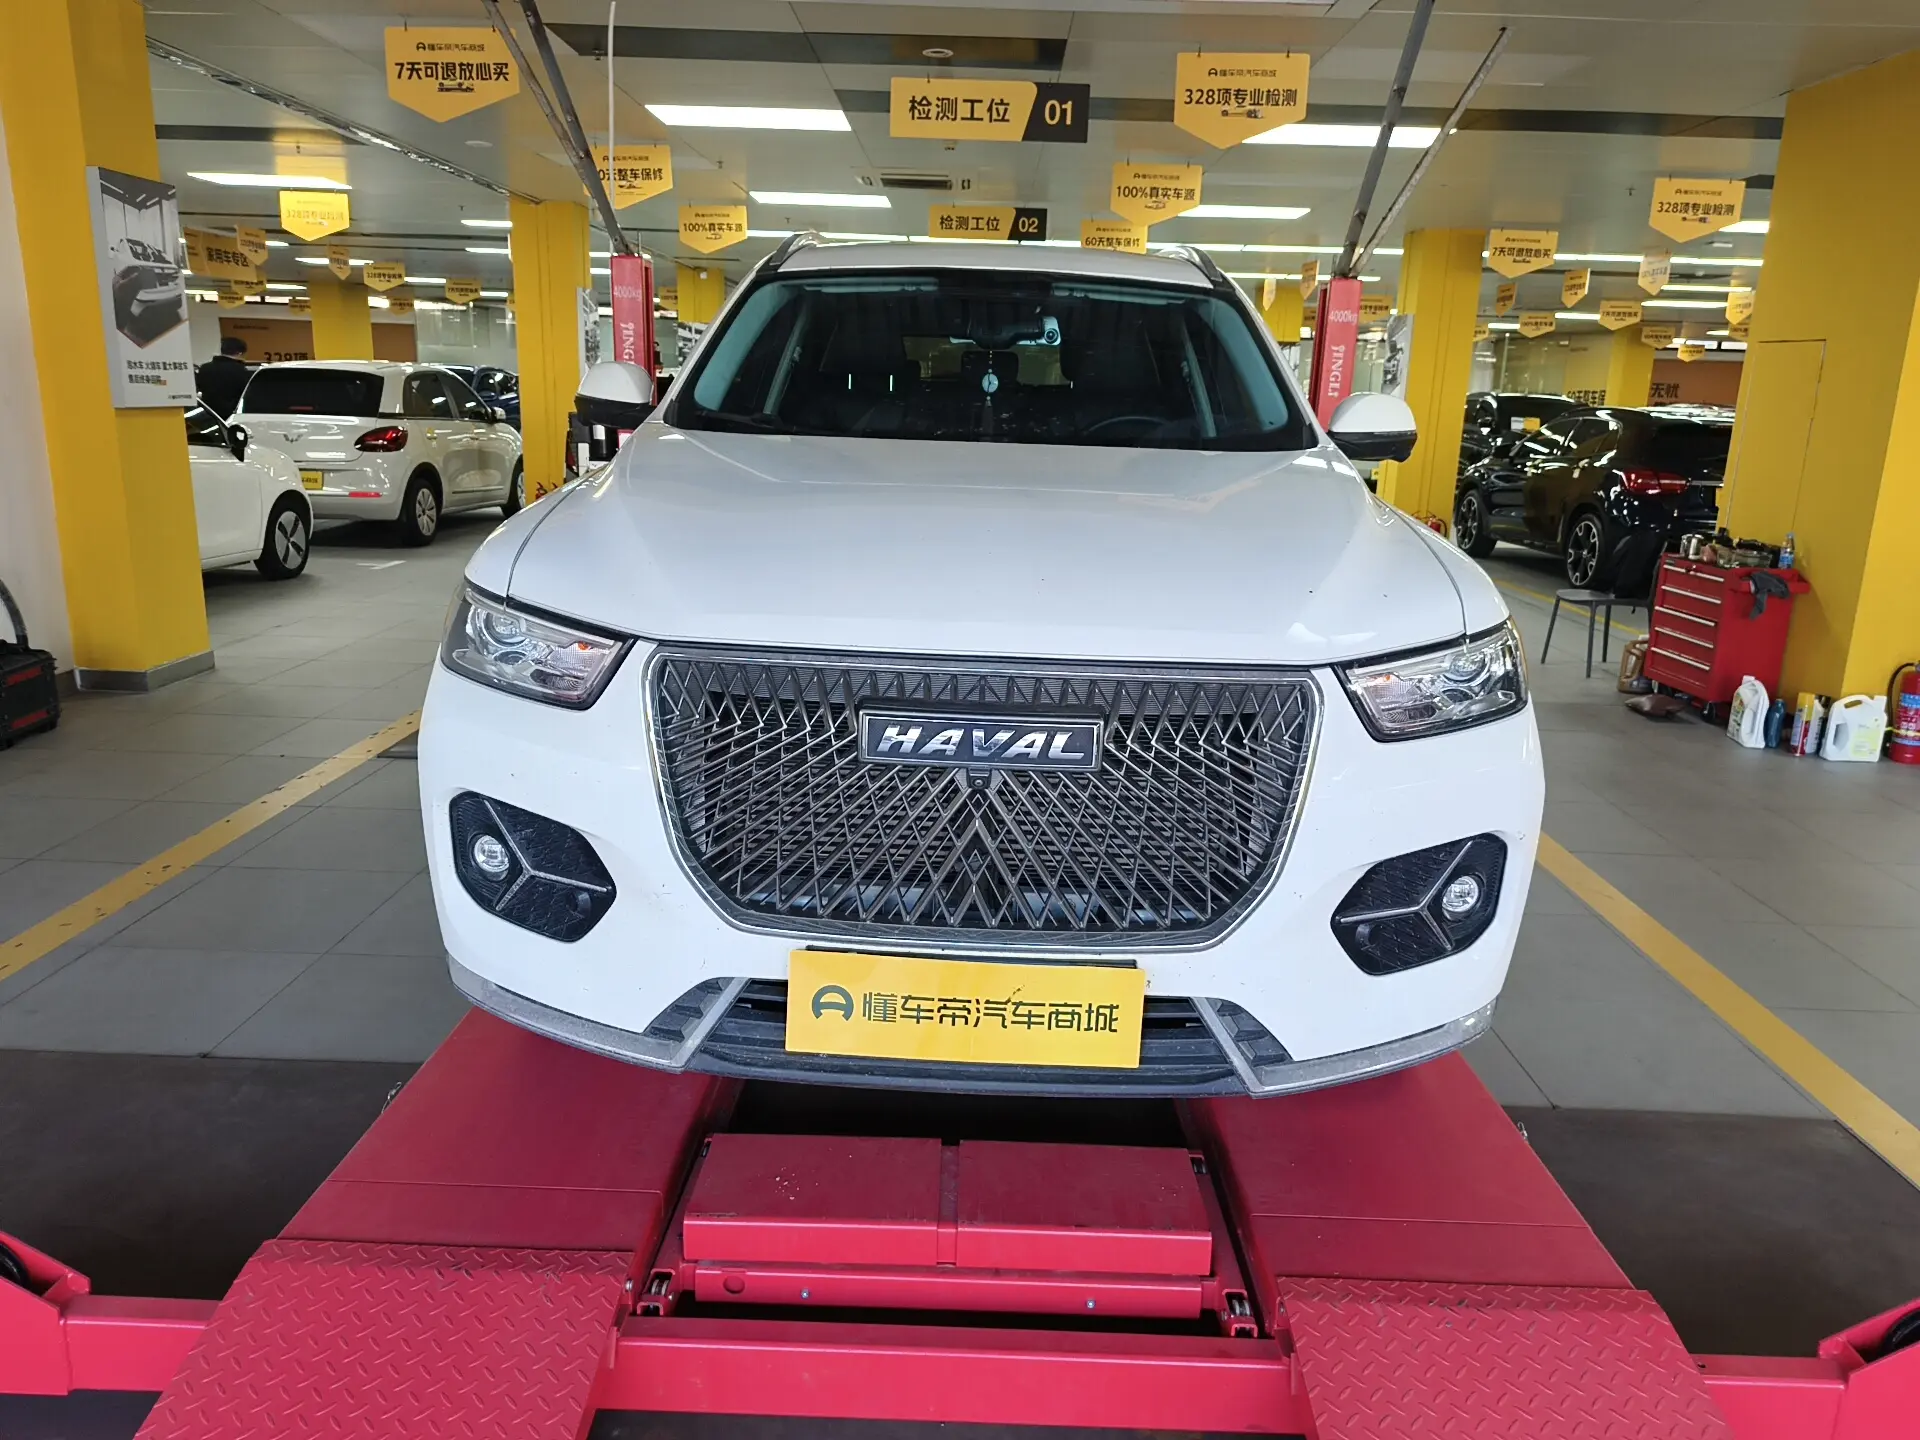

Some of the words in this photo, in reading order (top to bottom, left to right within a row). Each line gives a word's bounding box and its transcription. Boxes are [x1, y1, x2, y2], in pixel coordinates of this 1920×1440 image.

[394, 61, 509, 81] 7天可退放心买
[1184, 88, 1297, 107] 328项专业检测
[908, 95, 1010, 123] 检测工位
[1044, 100, 1072, 125] 01
[1116, 186, 1195, 201] 100%真实车源
[1657, 201, 1735, 216] 328项专业检测
[683, 222, 743, 233] 100%真实车源
[939, 215, 1000, 232] 检测工位
[1018, 217, 1039, 232] 02
[1085, 237, 1140, 248] 60天整车保修
[613, 285, 642, 301] 4000kg
[1328, 309, 1358, 326] 4000kg
[876, 725, 1085, 760] HAVAL
[862, 991, 1120, 1033] 懂车帝汽车商城
